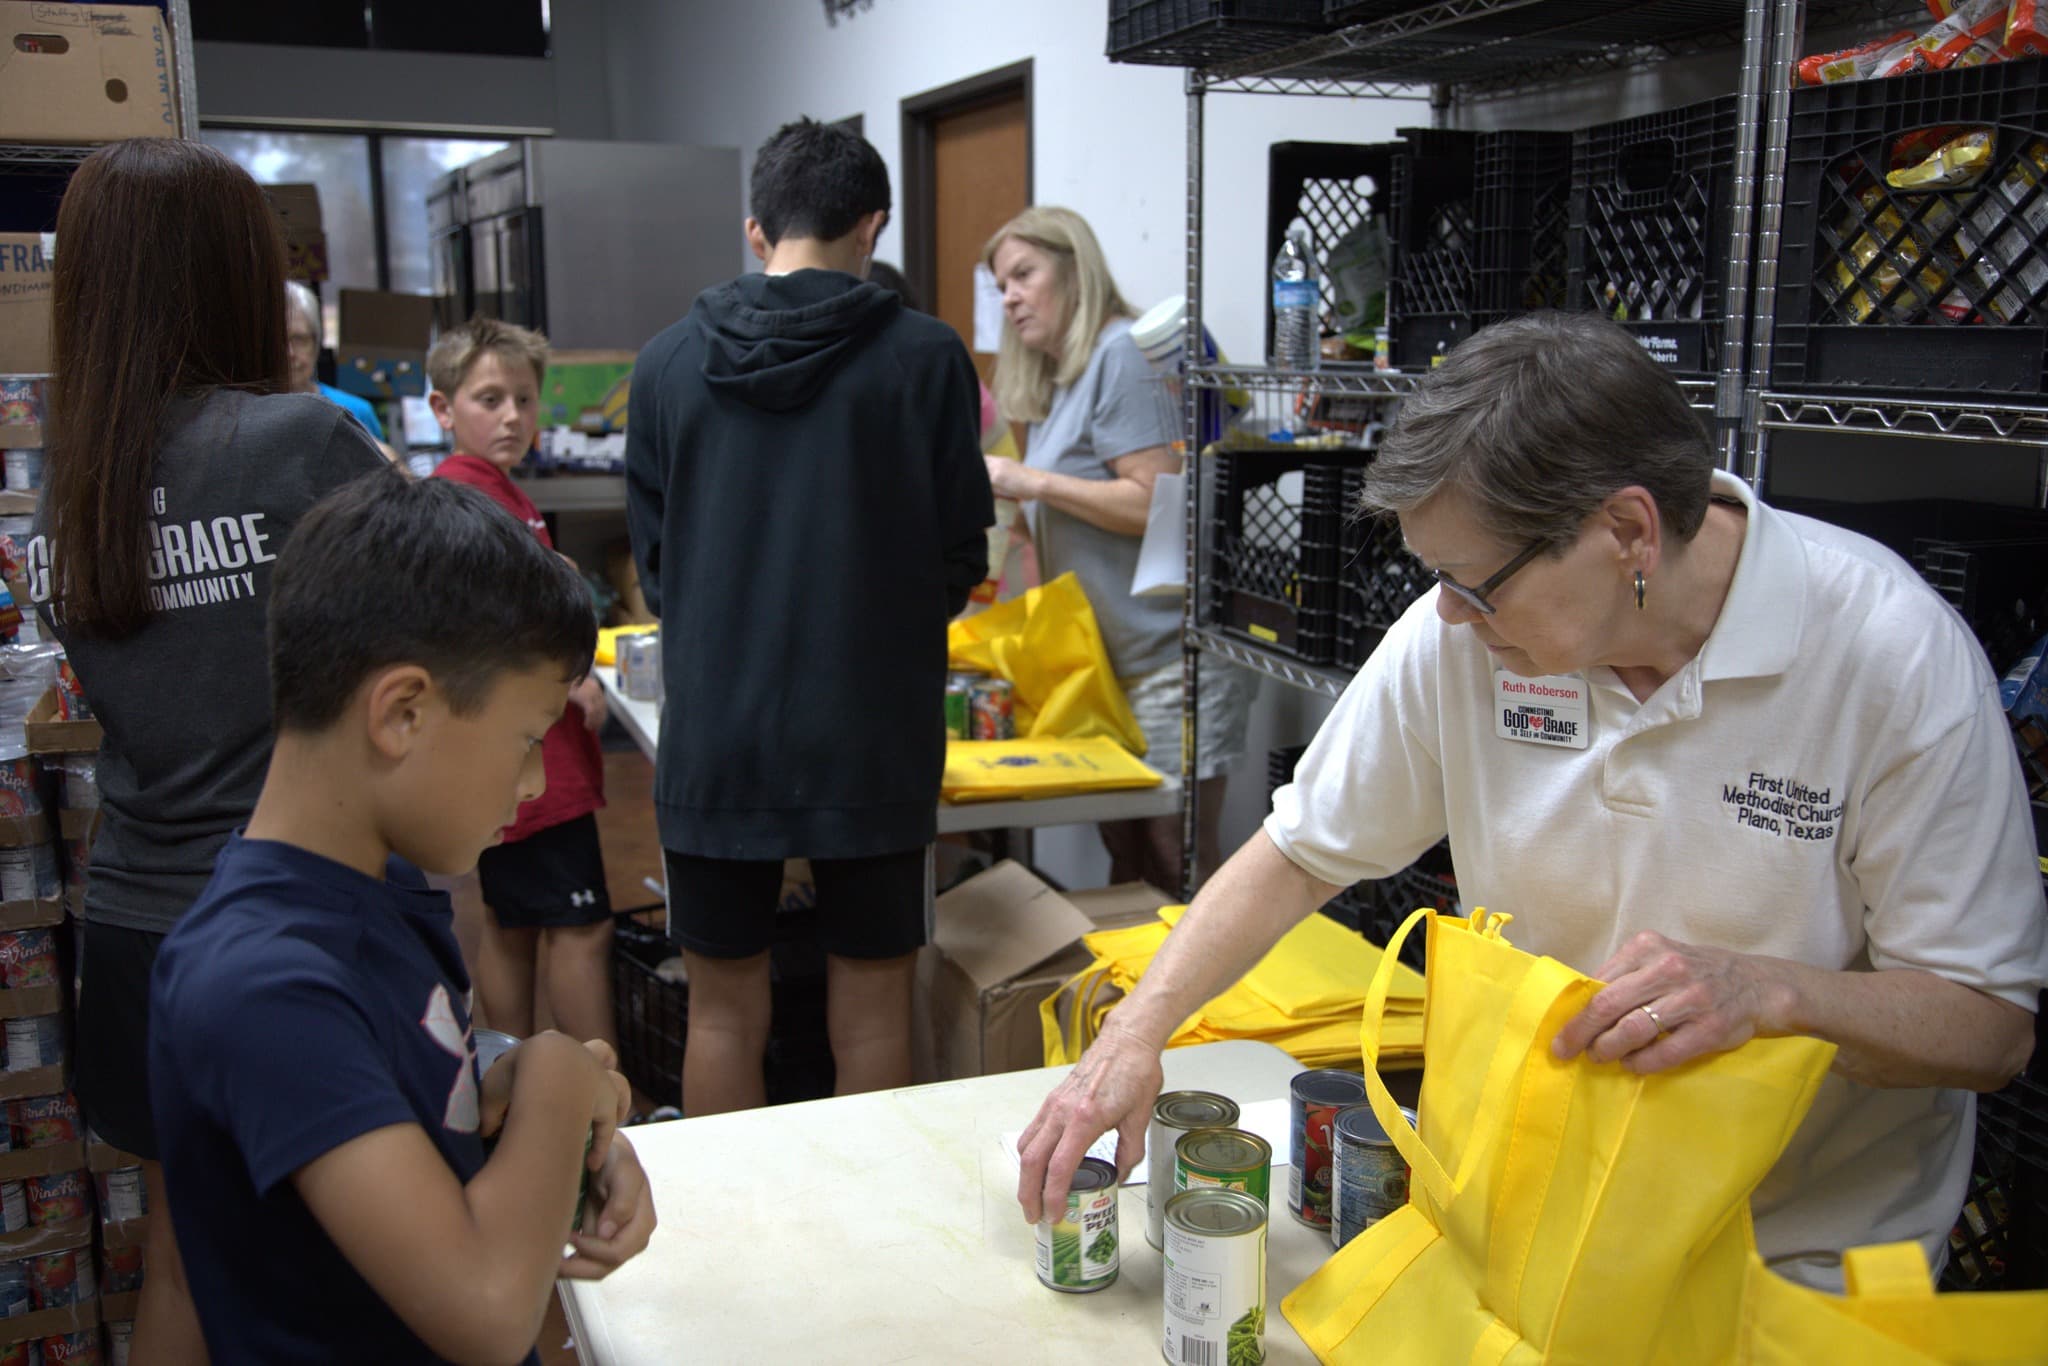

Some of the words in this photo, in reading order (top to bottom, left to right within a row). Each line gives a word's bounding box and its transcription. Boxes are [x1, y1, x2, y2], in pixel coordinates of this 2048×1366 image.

[1502, 680, 1526, 693] Ruth
[1529, 683, 1578, 699] Roberson
[1503, 708, 1529, 729] GOD
[1543, 717, 1578, 736] GRACE
[1540, 731, 1572, 743] COMMUNITY
[1722, 784, 1795, 818] Methodist
[1748, 772, 1783, 795] First
[1785, 779, 1830, 804] United
[1737, 807, 1781, 836] Plano,
[1785, 819, 1833, 841] Texas
